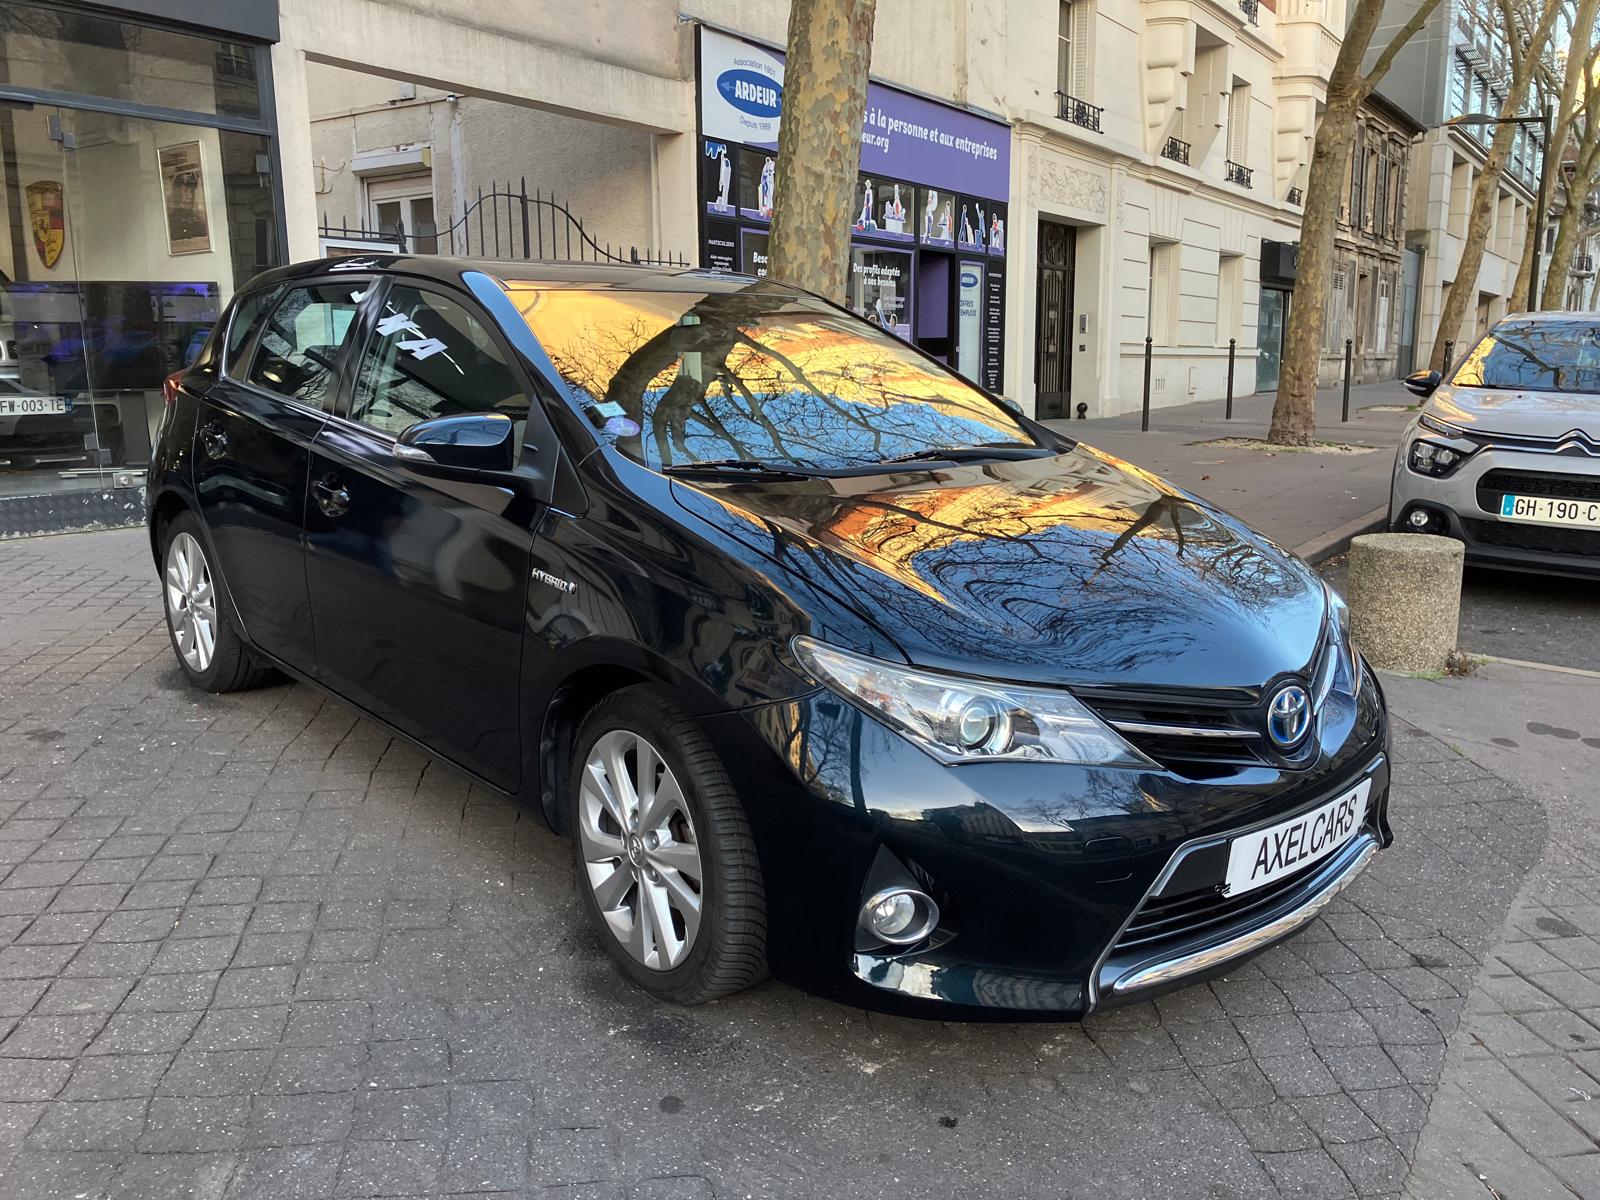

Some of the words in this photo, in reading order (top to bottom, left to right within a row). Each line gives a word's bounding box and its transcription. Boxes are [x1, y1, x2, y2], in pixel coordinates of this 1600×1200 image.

[733, 58, 763, 70] Association
[735, 80, 777, 108] ARDEUR
[740, 116, 758, 130] Depuis
[869, 107, 876, 126] à
[877, 108, 887, 128] la
[887, 117, 928, 135] personne
[929, 127, 939, 143] et
[939, 132, 954, 147] aux
[955, 136, 998, 160] entreprises
[853, 262, 863, 273] Des
[863, 264, 880, 277] profils
[877, 276, 896, 288] besoins
[0, 398, 64, 413] FW-003-TE
[1515, 498, 1600, 521] GH-190-C
[531, 567, 568, 593] HYBRID
